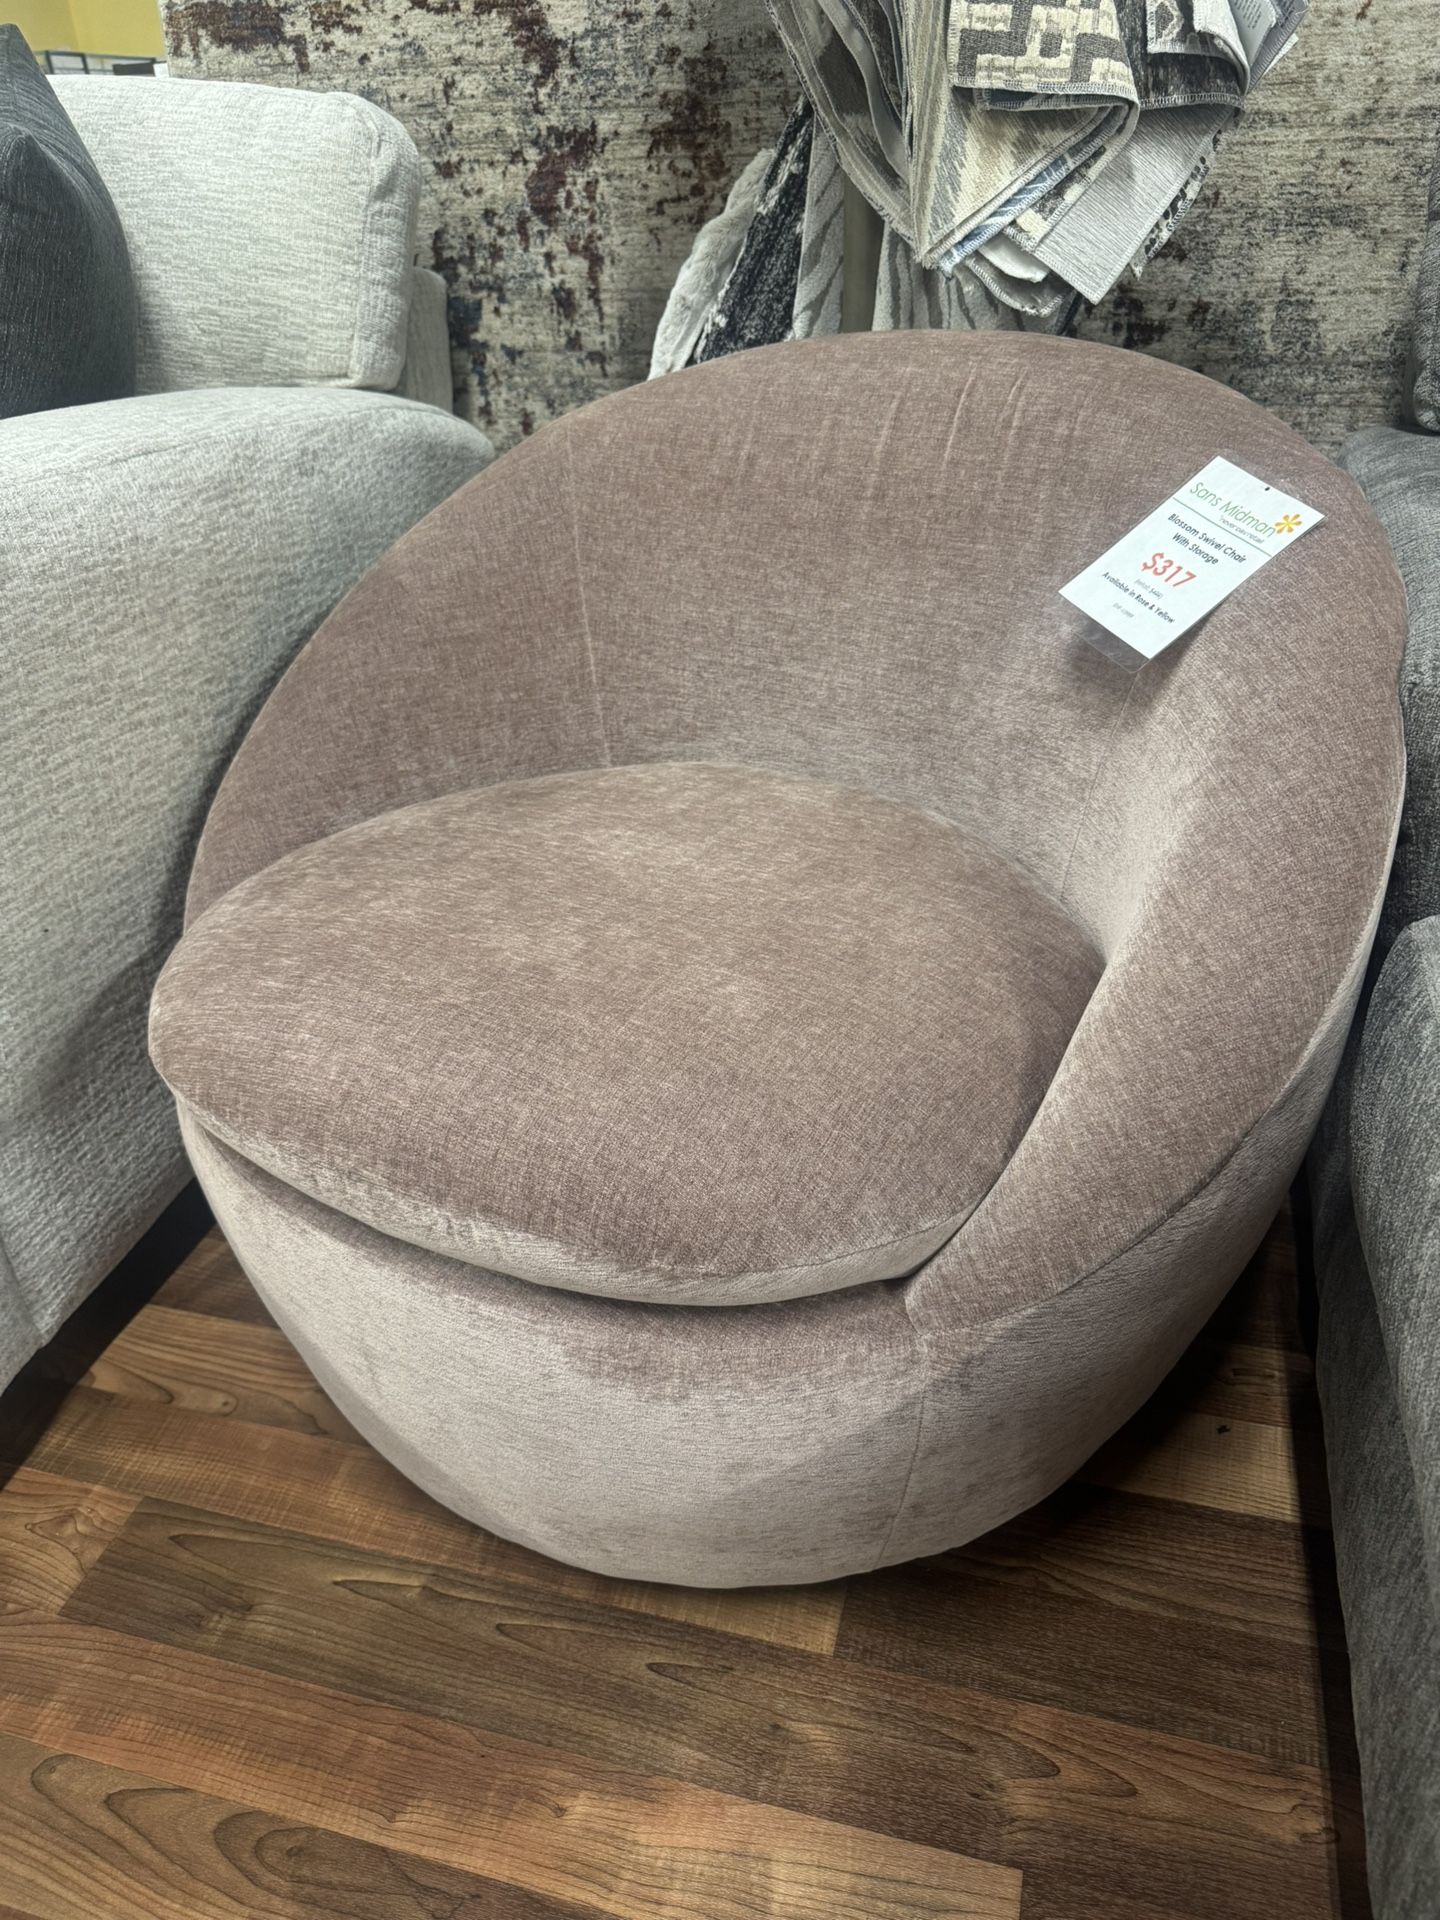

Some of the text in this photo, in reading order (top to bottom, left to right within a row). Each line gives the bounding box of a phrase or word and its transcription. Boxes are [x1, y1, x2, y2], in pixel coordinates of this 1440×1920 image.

[1190, 481, 1276, 538] Sans Midman
[1167, 512, 1247, 564] Blossom Swivel Chair
[1172, 532, 1219, 565] With Storage
[1141, 552, 1197, 588] $317
[1102, 572, 1130, 592] Available
[1134, 593, 1150, 608] Rose
[1155, 607, 1175, 623] Yellow
